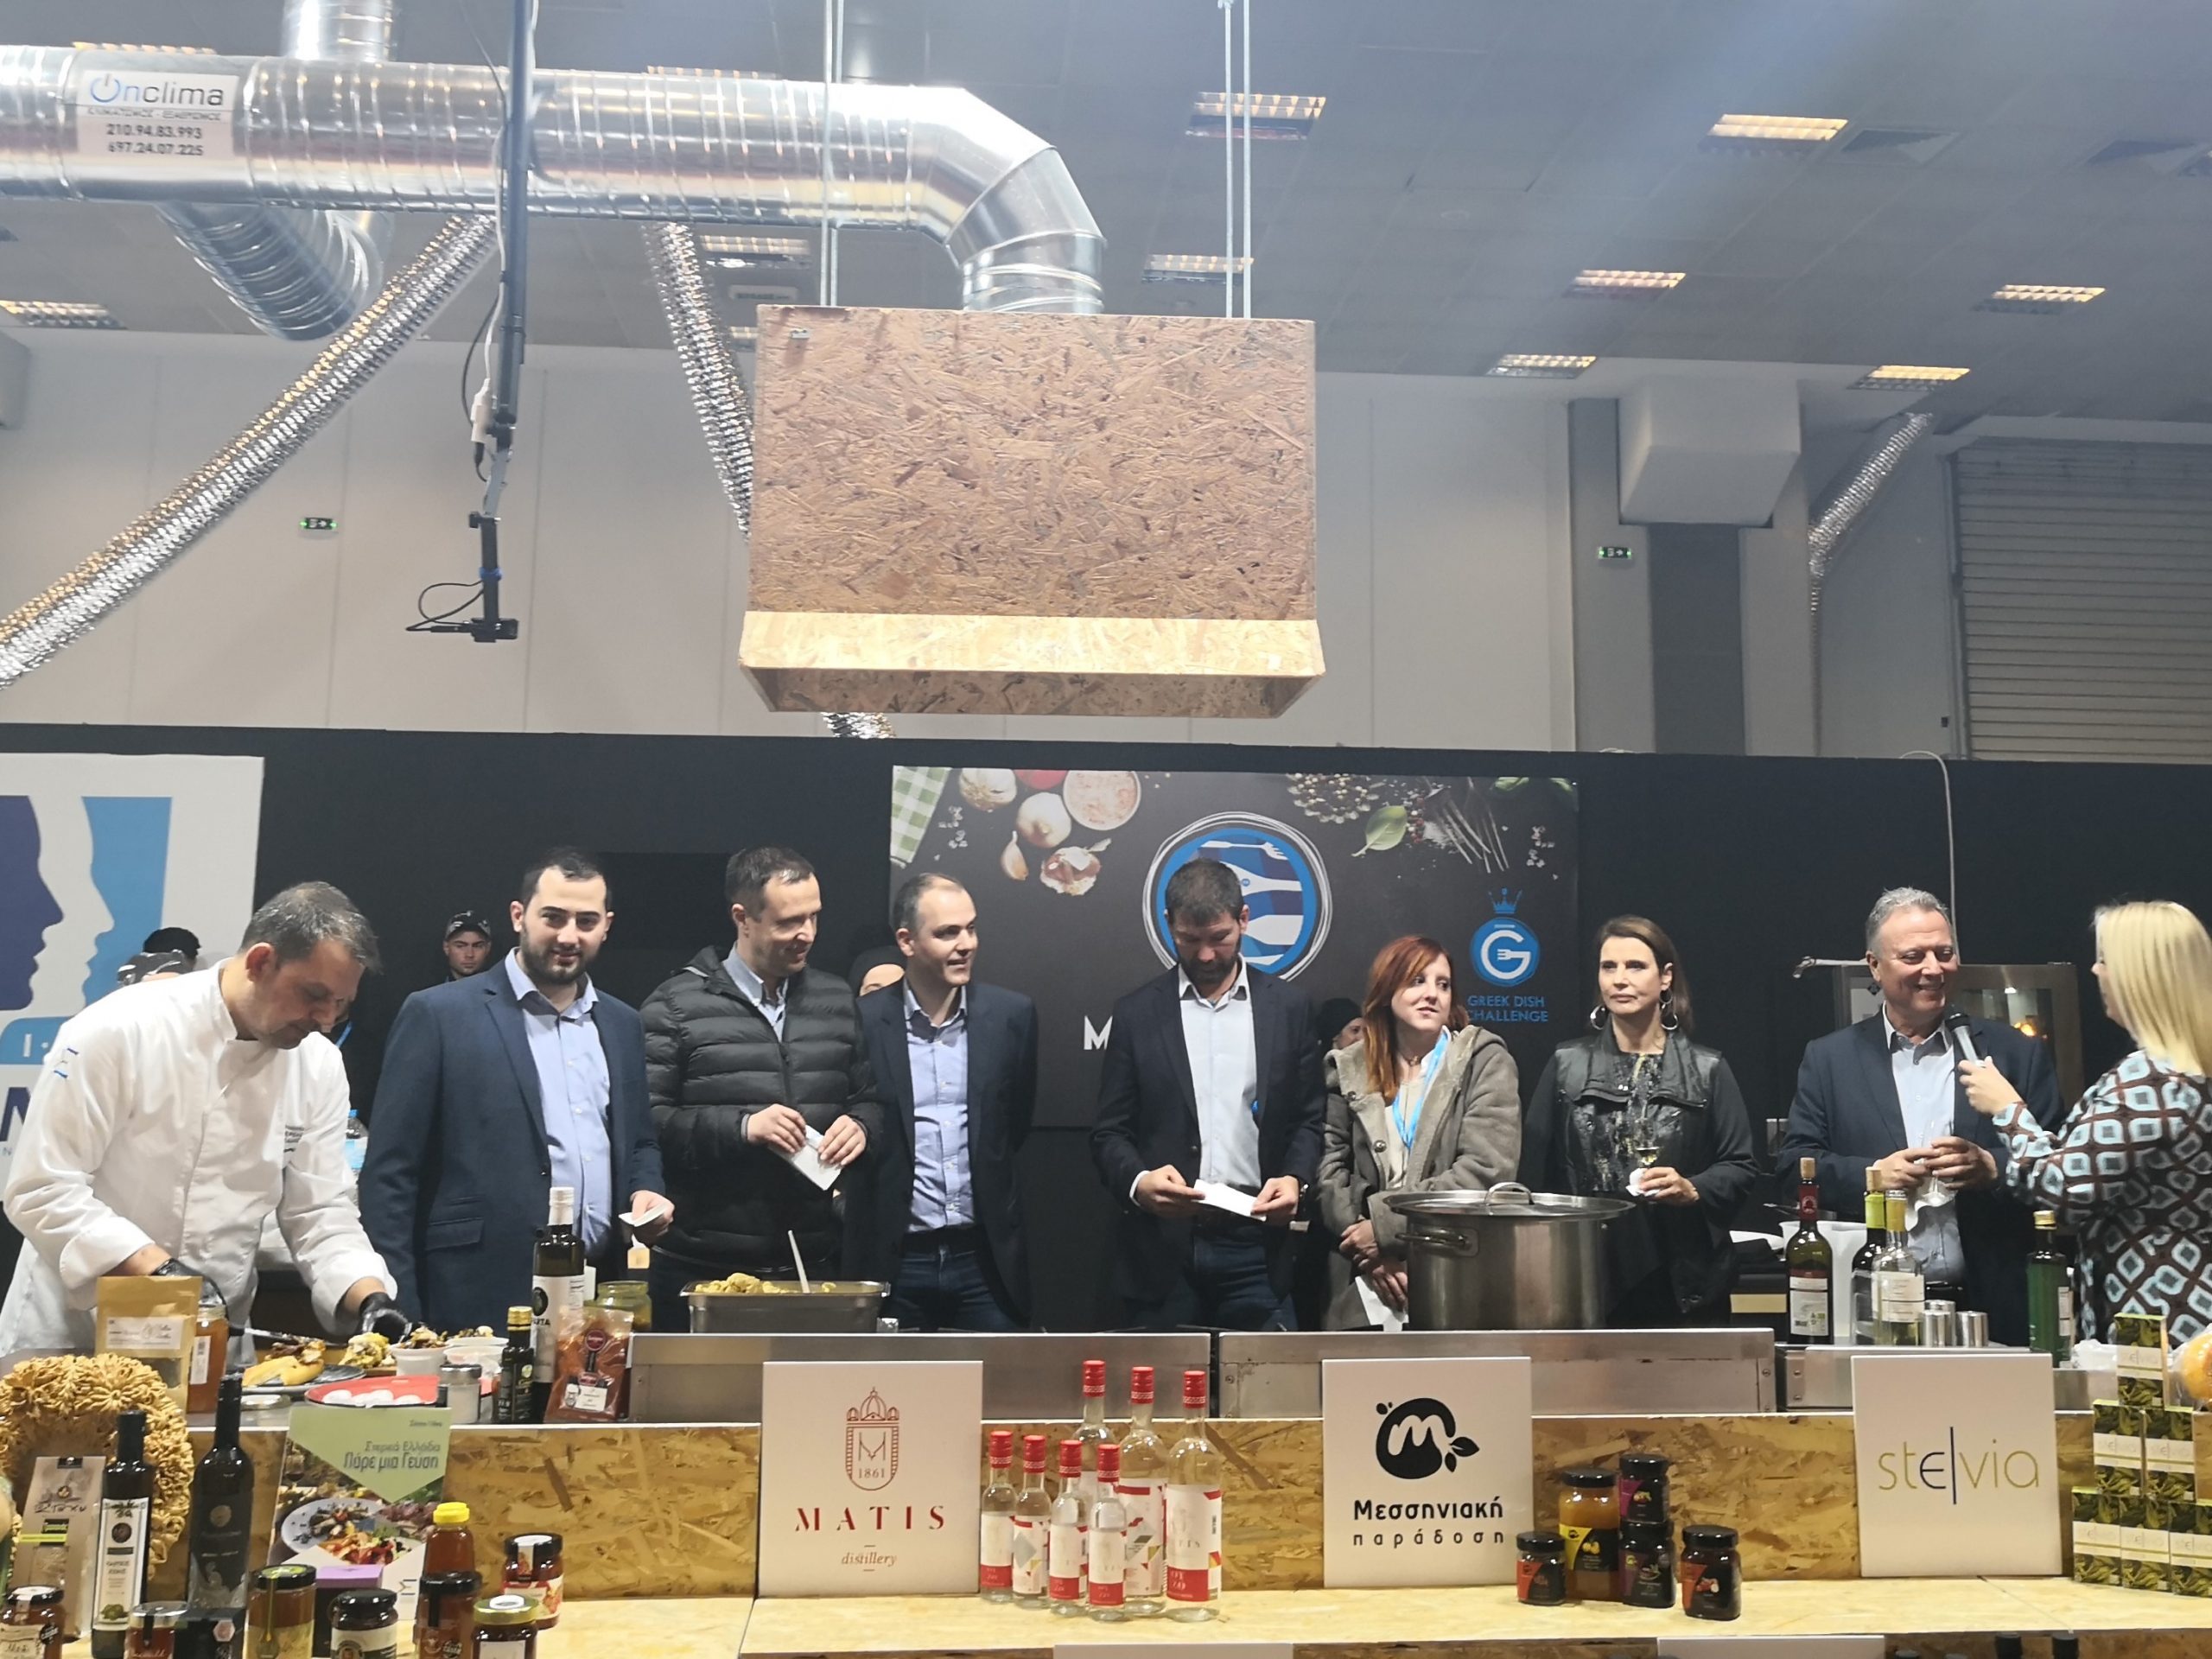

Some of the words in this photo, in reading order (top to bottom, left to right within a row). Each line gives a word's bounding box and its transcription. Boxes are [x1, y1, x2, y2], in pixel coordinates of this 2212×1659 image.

[1468, 995, 1510, 1007] GREEK
[1514, 996, 1545, 1007] DISH
[858, 1468, 886, 1478] 1861
[1878, 1426, 2040, 1504] stelvia
[795, 1505, 944, 1532] MATIS
[1353, 1496, 1503, 1521] Μεσσηνιακή
[1353, 1528, 1504, 1548] παράδοση
[841, 1552, 897, 1567] distillery
